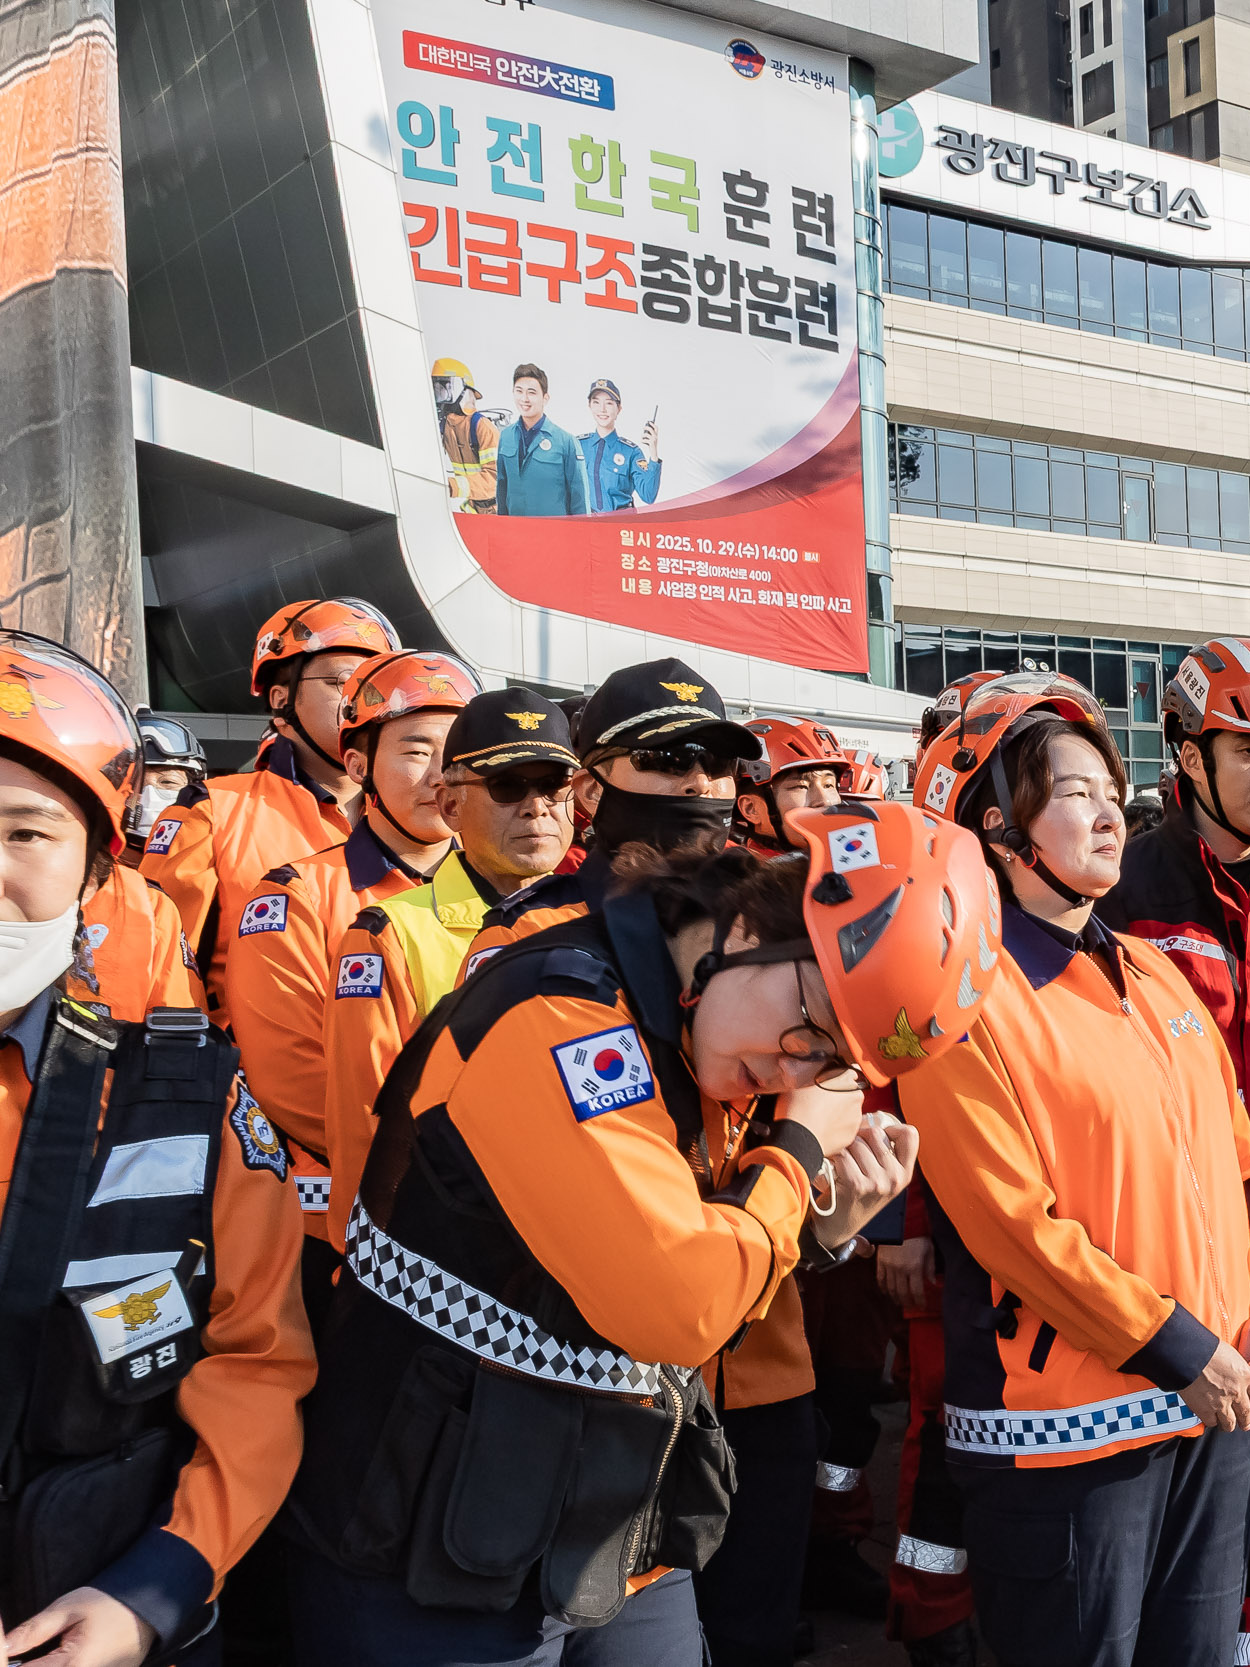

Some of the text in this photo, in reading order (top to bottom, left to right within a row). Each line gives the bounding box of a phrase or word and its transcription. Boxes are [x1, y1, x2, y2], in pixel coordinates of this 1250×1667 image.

[418, 42, 601, 102] 대한민국 안전大전환
[770, 59, 835, 95] 광진소방서
[935, 124, 1212, 231] 광진구보건소
[656, 534, 695, 553] 2025.
[697, 538, 716, 555] 10.
[762, 545, 798, 563] 14:00
[749, 569, 772, 583] 400)
[657, 580, 697, 600] 사업장
[699, 584, 725, 602] 인적
[727, 587, 757, 605] 사고,
[758, 589, 784, 607] 화재
[785, 592, 799, 608] 및
[800, 594, 826, 611] 인파
[827, 597, 853, 614] 사고
[1181, 665, 1206, 700] 서울광진
[242, 923, 279, 935] KOREA
[1179, 939, 1204, 953] 구조대
[338, 986, 373, 995] KOREA
[587, 1084, 648, 1112] KOREA
